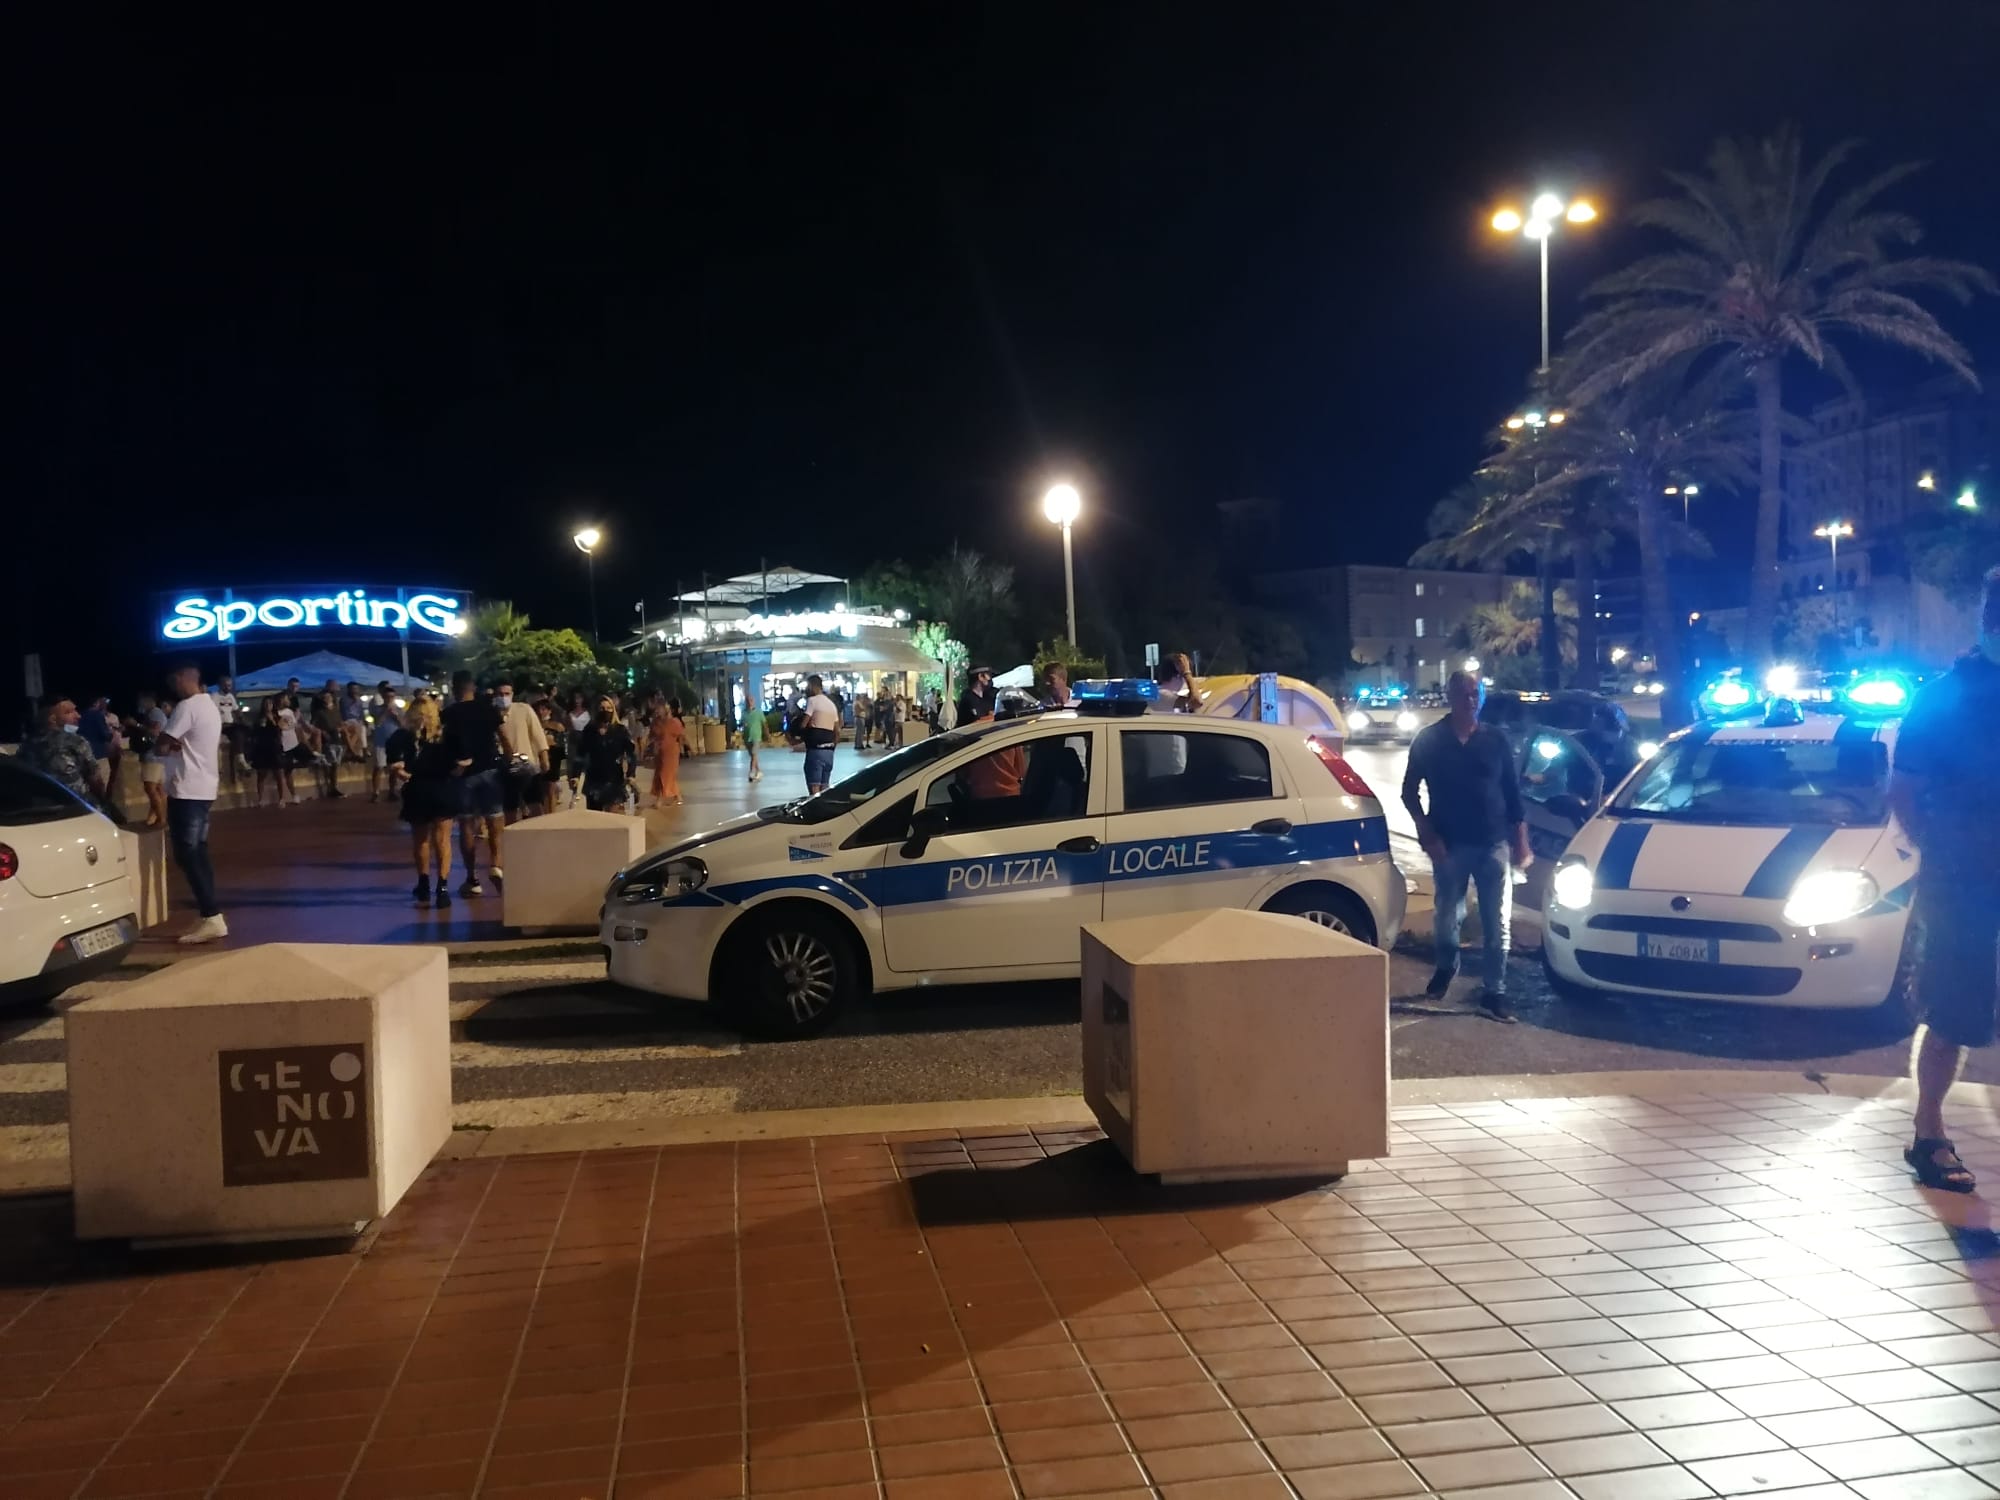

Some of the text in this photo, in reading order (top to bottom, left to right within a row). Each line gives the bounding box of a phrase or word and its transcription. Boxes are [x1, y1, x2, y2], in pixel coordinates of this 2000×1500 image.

[947, 840, 1212, 892] POLIZIA LOCALE
[1649, 943, 1663, 957] YA
